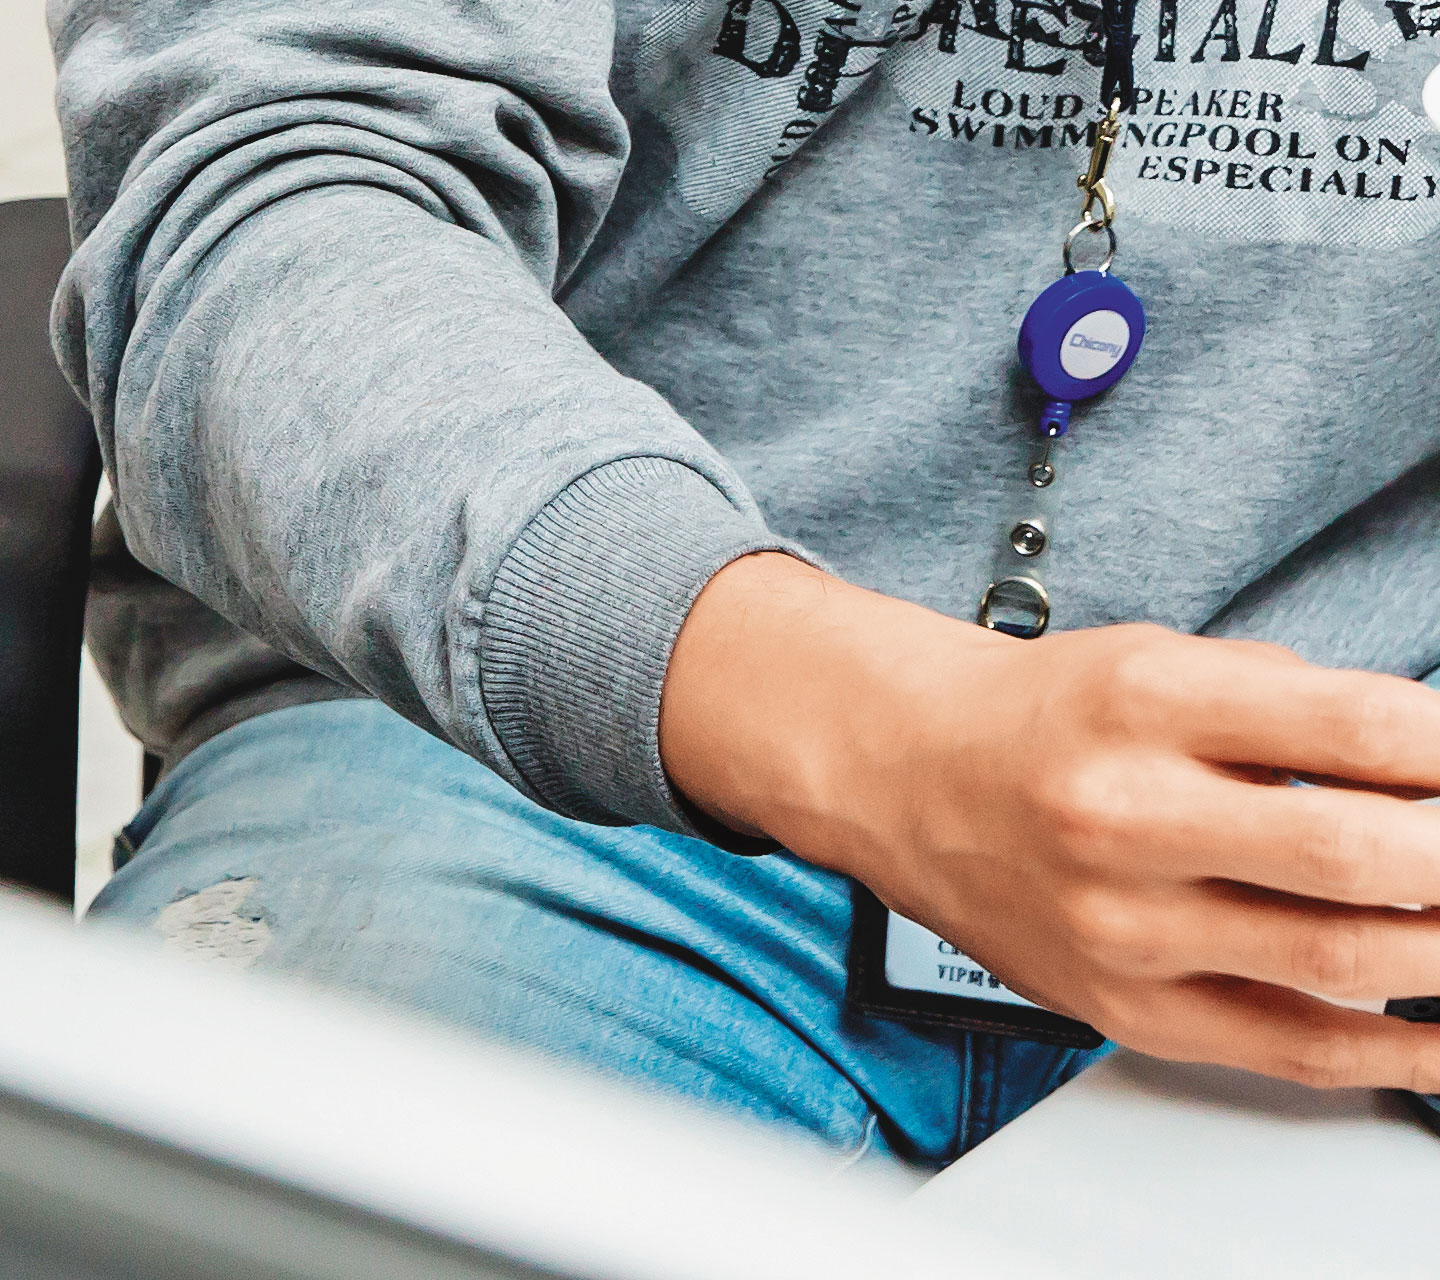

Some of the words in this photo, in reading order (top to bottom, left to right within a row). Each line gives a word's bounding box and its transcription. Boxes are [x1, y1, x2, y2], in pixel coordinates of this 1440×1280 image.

[952, 79, 1086, 121] LOUD
[1098, 88, 1284, 124] PEAKER
[909, 106, 1317, 162] SWIMMNGPOOL
[1336, 132, 1412, 166] ON
